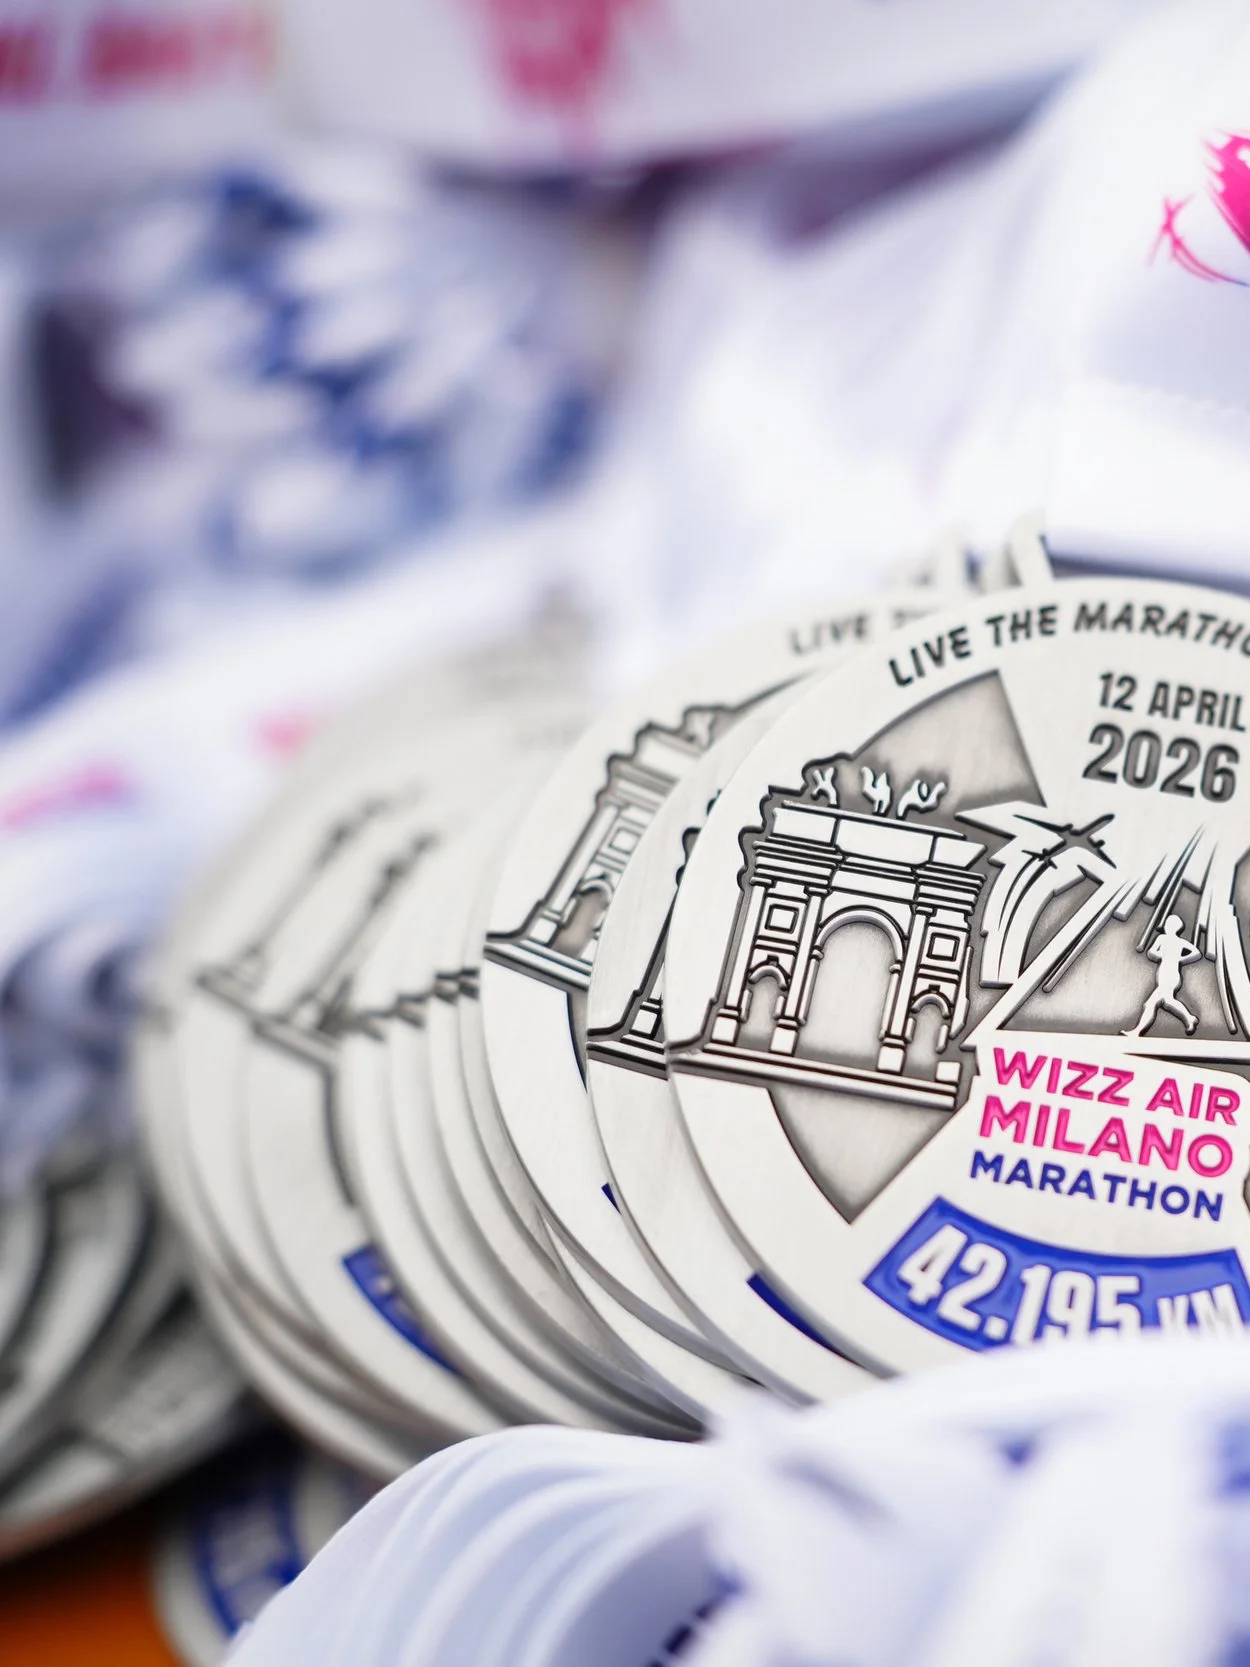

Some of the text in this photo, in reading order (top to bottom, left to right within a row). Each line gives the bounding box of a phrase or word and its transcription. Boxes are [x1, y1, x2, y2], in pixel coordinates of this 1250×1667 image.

[789, 609, 870, 655] LIVE
[889, 625, 973, 687] LIVE
[986, 604, 1058, 647] THE
[1099, 672, 1247, 733] 12 APRIL
[1082, 722, 1241, 804] 2026
[993, 1047, 1241, 1126] WIZZ AIR
[979, 1094, 1234, 1178] MILANO
[970, 1149, 1224, 1222] MARATHON
[897, 1223, 1144, 1346] 42.195
